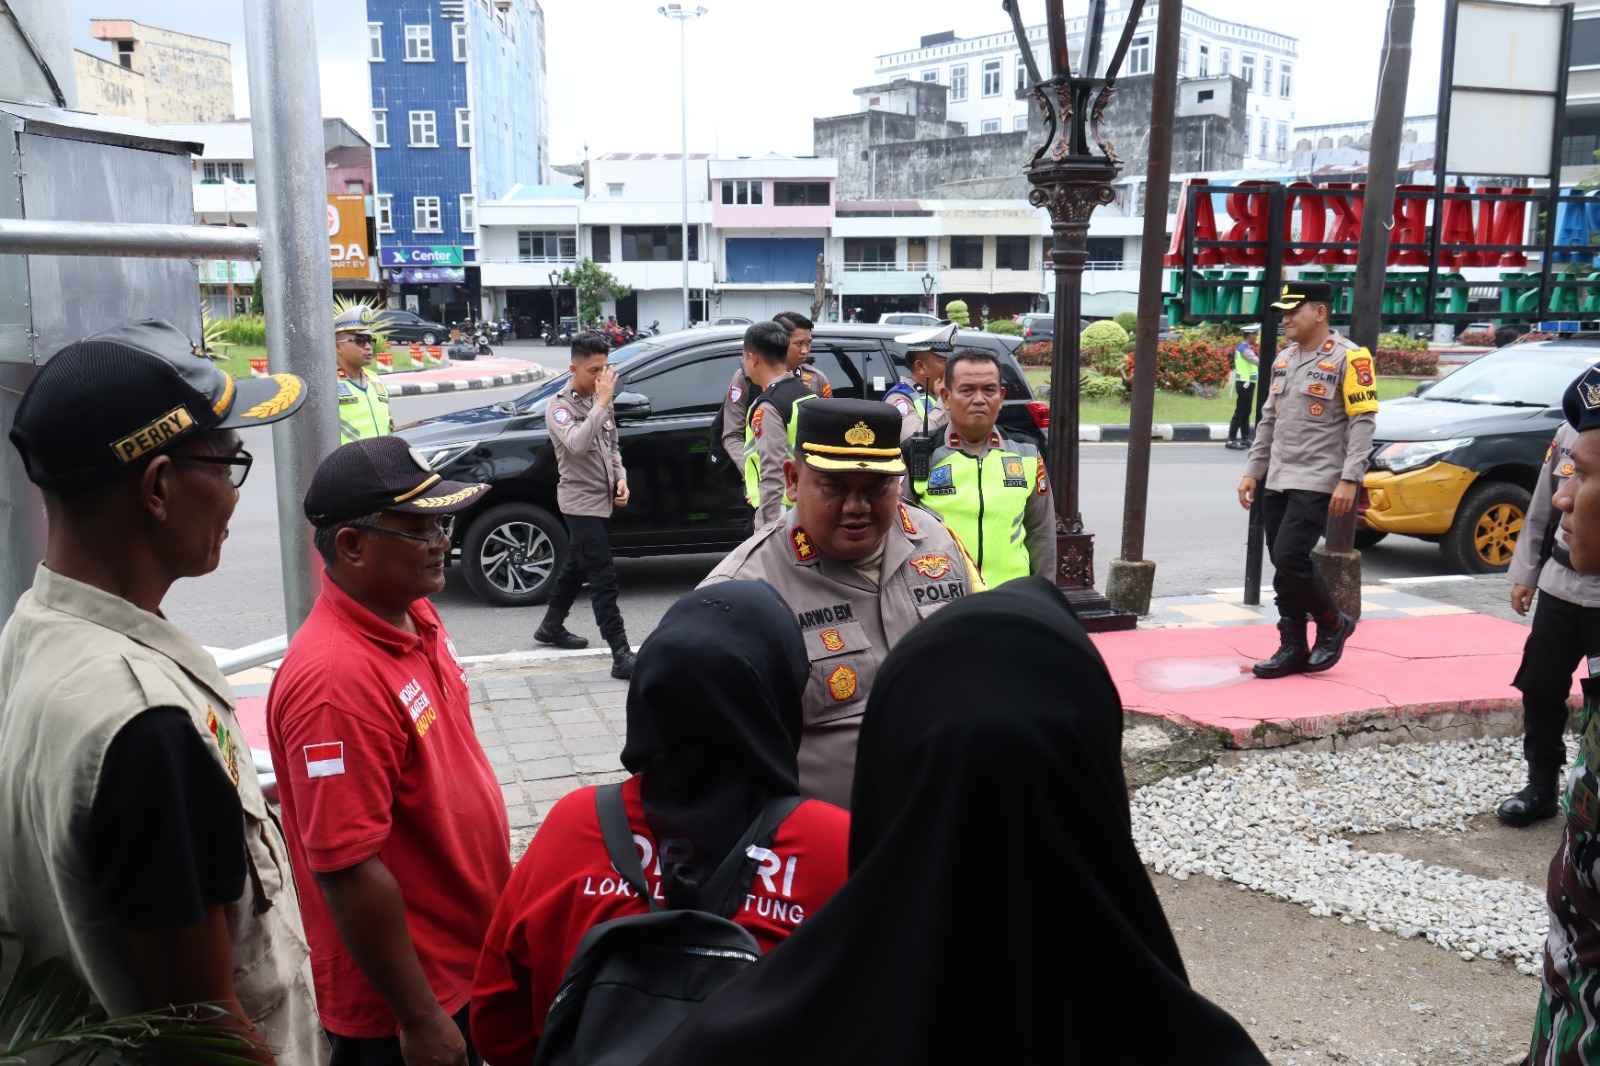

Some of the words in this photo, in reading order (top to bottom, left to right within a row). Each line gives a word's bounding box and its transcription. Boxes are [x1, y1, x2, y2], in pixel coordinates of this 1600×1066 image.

[412, 250, 452, 261] Center
[1306, 371, 1336, 384] POLRI
[121, 413, 183, 458] PERRY
[913, 582, 965, 603] POLRI
